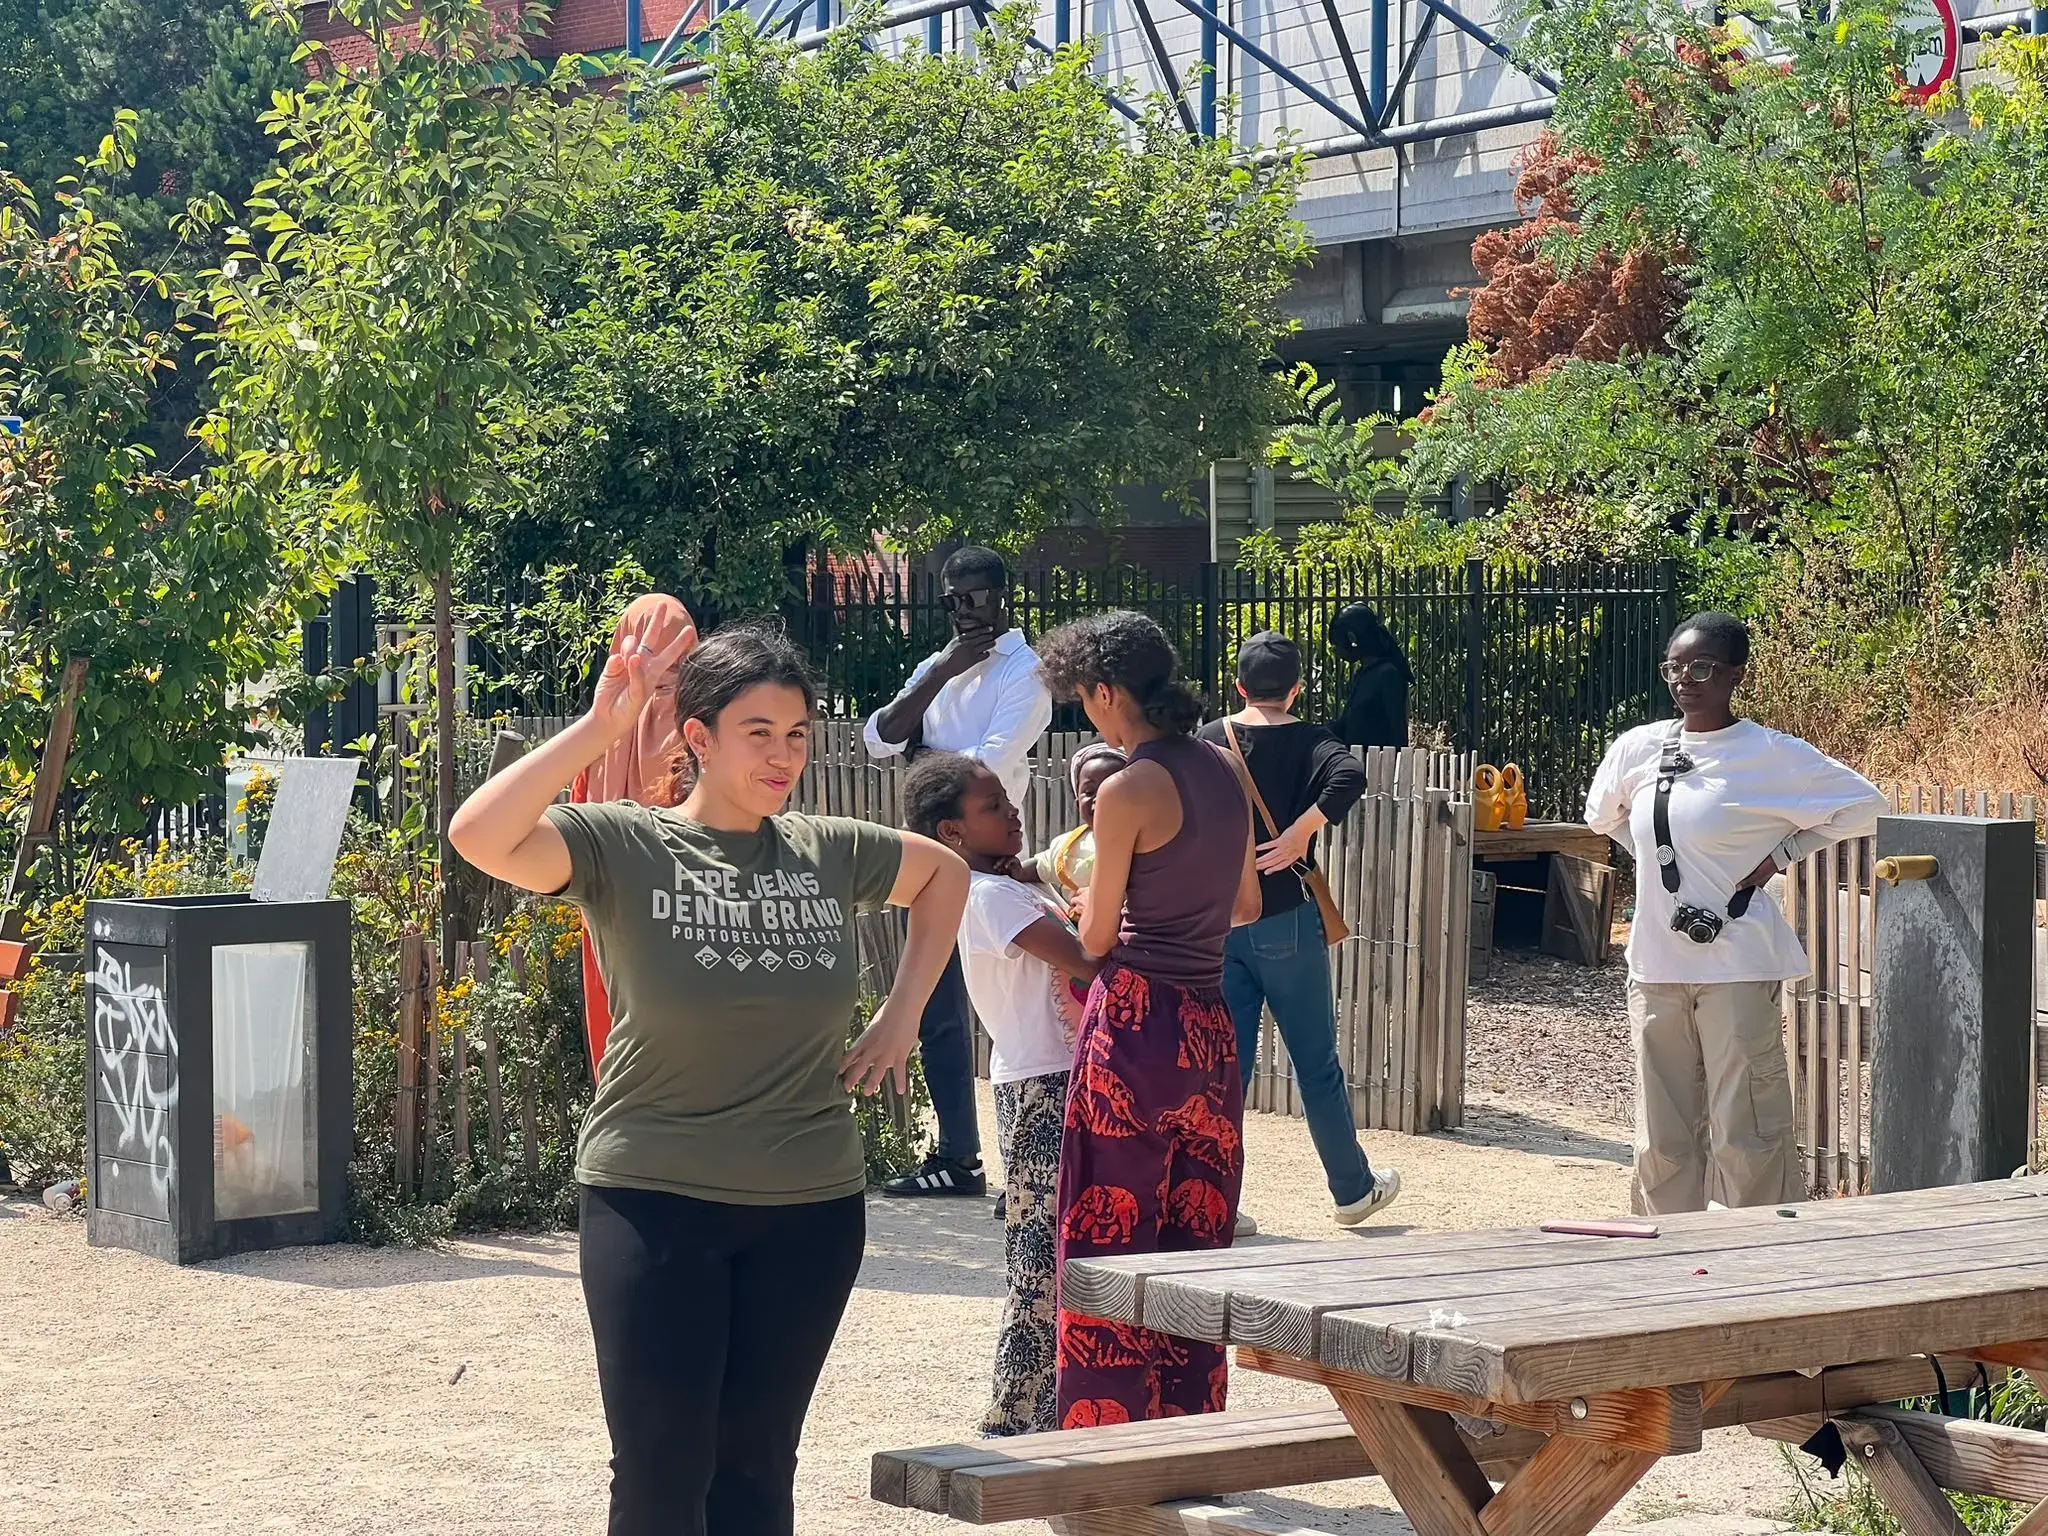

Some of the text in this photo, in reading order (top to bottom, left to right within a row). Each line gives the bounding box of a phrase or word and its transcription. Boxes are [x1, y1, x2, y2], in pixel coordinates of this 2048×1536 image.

[747, 869, 820, 899] JEANS
[652, 889, 843, 930] DENIM BRAND
[672, 924, 781, 946] PORTOBELLO
